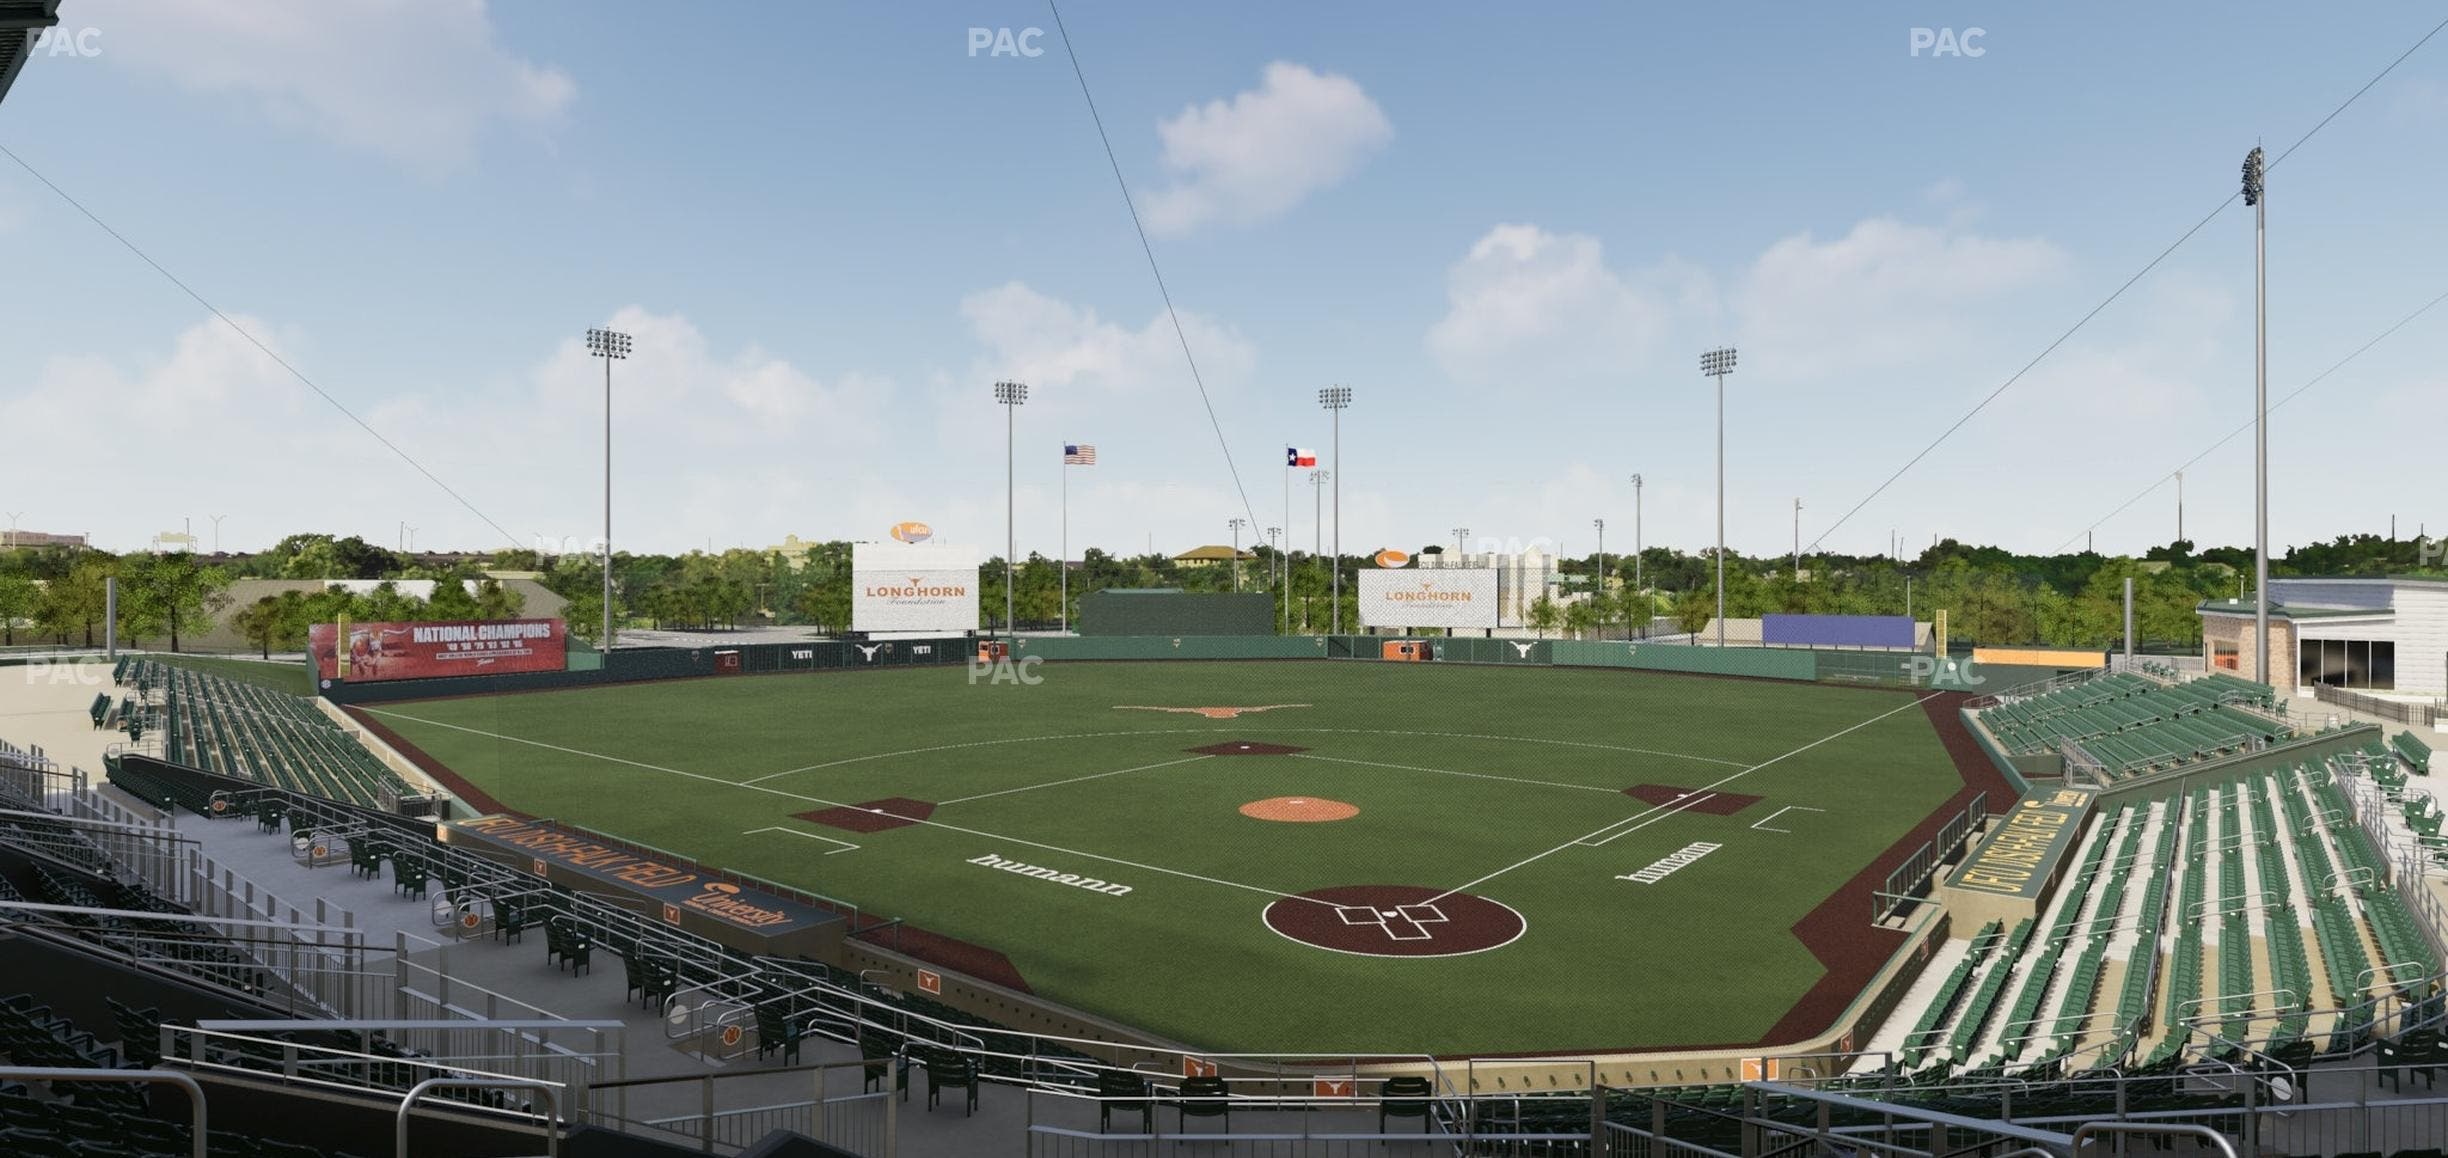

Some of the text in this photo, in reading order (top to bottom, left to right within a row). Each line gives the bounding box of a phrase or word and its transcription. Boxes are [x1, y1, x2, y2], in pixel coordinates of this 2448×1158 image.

[866, 587, 965, 597] LONGHORN
[1385, 592, 1473, 601] LONGHORN
[413, 623, 550, 643] NATIONAL CHAMPIONS
[791, 650, 813, 660] YETI
[912, 645, 931, 655] YETI
[1615, 841, 1723, 884] humann
[965, 853, 1133, 897] humann
